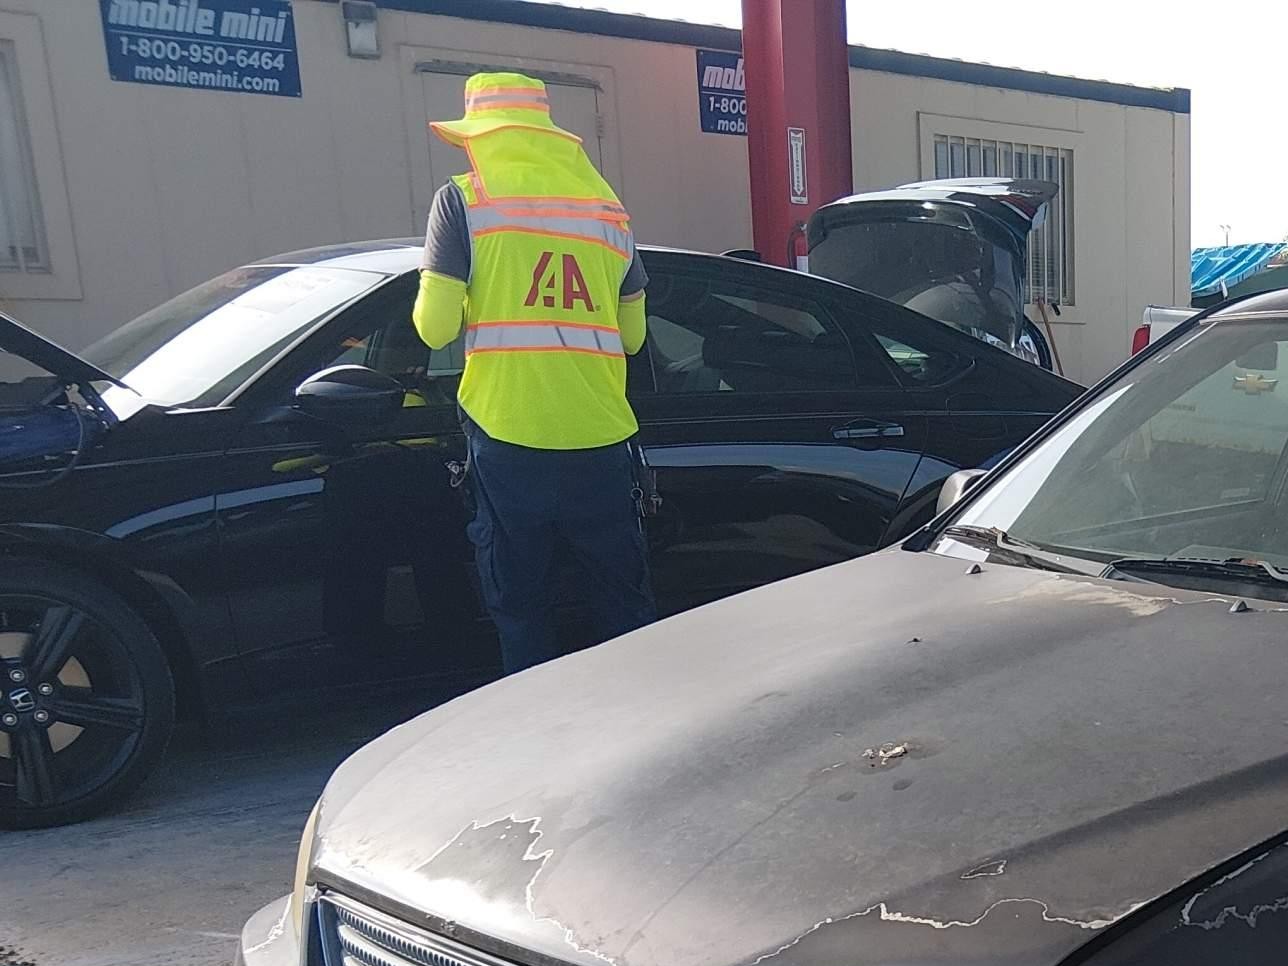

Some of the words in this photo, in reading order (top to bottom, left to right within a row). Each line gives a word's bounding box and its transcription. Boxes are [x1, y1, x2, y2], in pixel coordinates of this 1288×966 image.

[108, 0, 216, 36] mobile
[220, 8, 290, 43] mini
[119, 36, 286, 71] 1-800-950-6464
[134, 65, 280, 92] mobilemini.com
